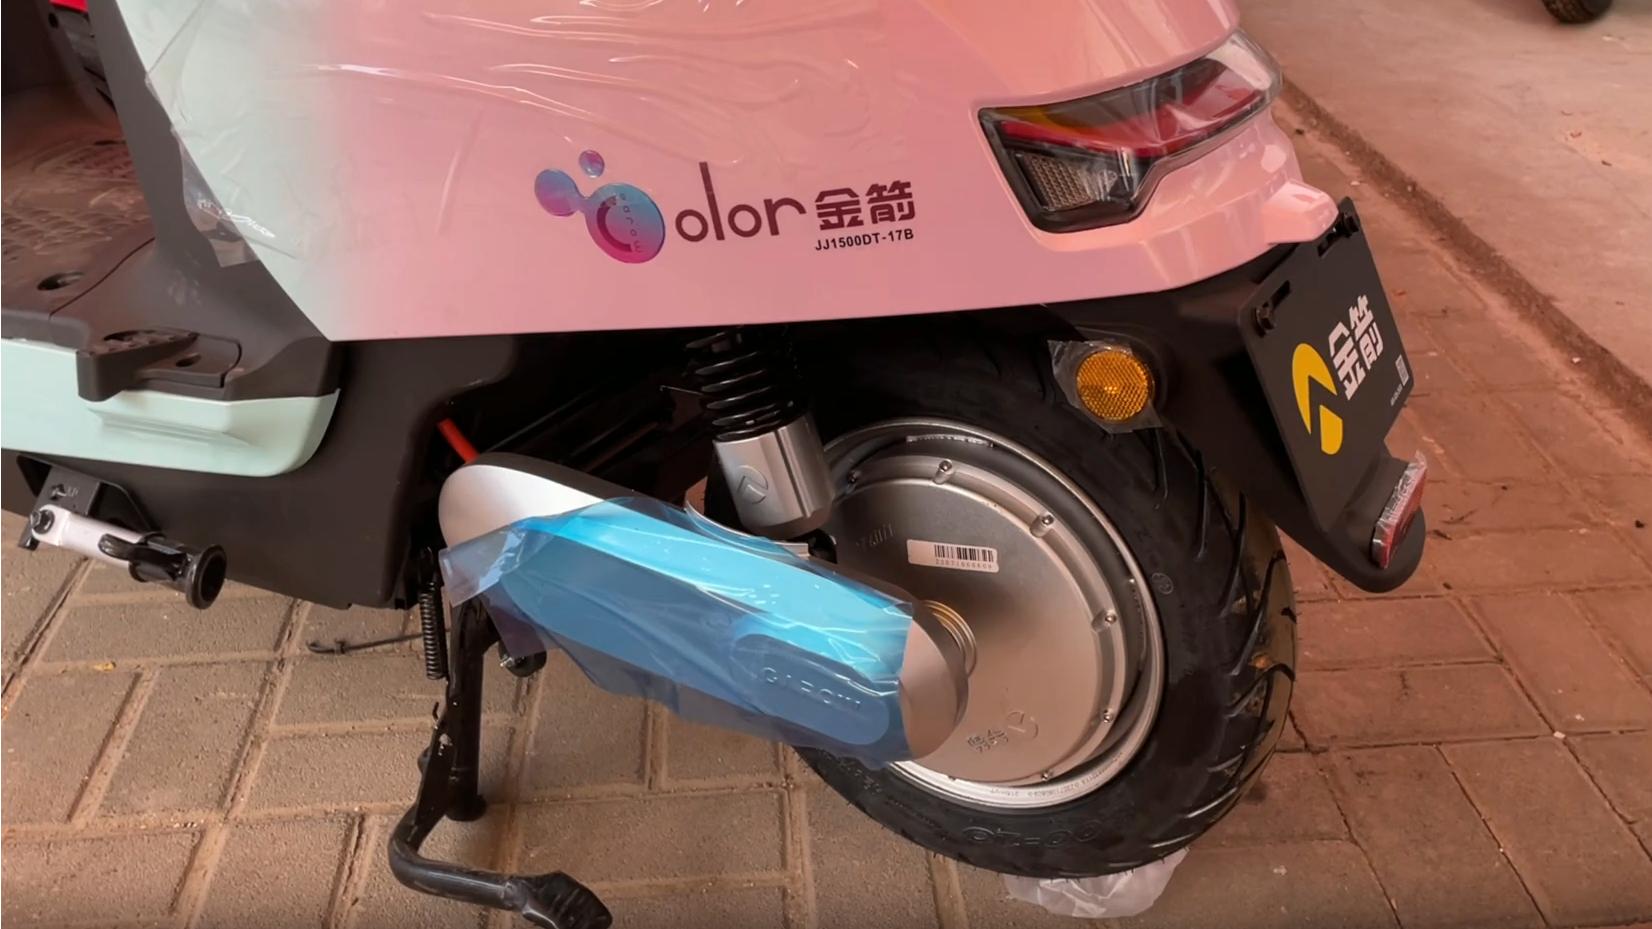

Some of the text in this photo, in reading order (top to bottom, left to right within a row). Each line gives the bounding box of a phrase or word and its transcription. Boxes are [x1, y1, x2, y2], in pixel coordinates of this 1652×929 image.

[815, 180, 915, 230] 金箭
[815, 228, 914, 250] JJ1500DT-17B
[1328, 295, 1384, 400] 金箭
